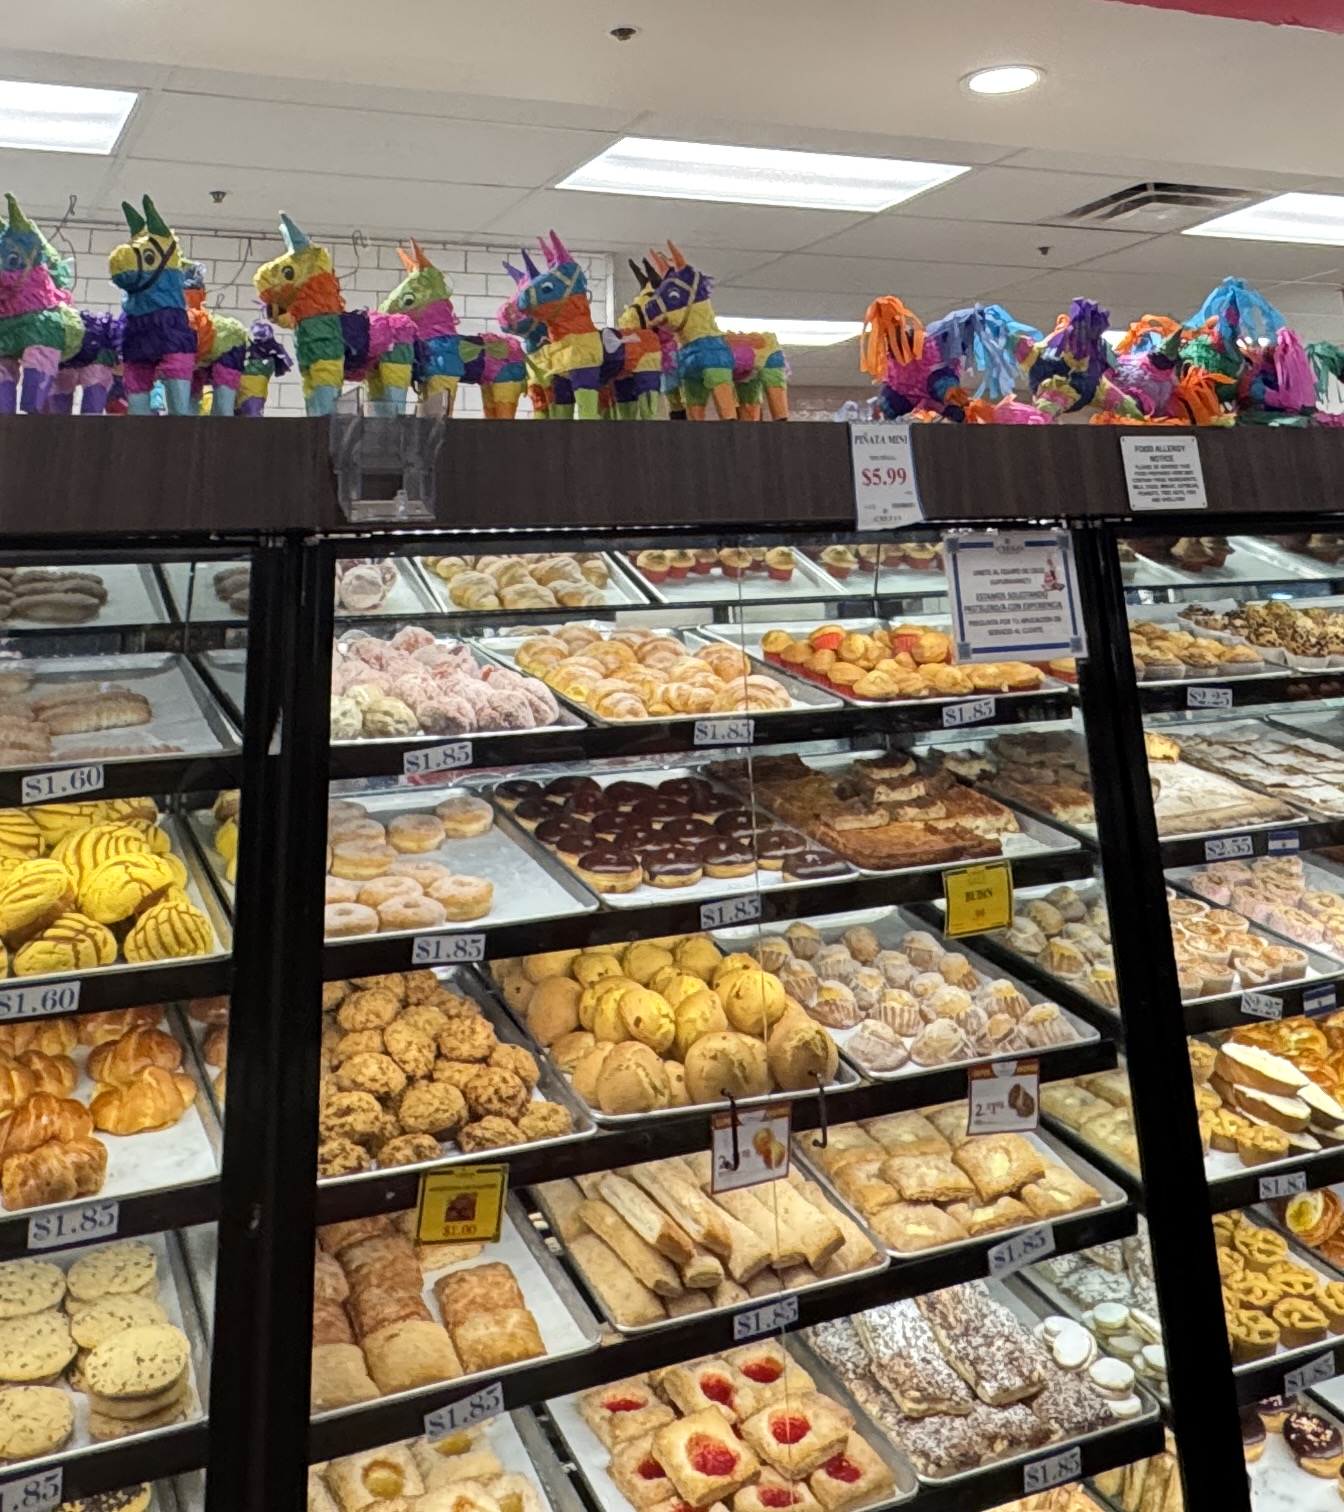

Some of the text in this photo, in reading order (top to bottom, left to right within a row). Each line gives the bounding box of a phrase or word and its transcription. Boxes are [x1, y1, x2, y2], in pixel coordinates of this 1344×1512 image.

[887, 434, 908, 445] MINI
[861, 467, 907, 487] $5.99
[944, 700, 994, 725] $1.85
[1188, 689, 1231, 706] $2.25
[696, 721, 752, 741] $1.85
[405, 744, 471, 774] $1.85
[25, 766, 103, 799] $1.60
[702, 897, 760, 927] $1.85
[415, 938, 483, 961] $1.85
[32, 1202, 116, 1242] $1.85
[992, 1229, 1047, 1269] $1.85
[736, 1300, 798, 1336] $1.85
[428, 1386, 502, 1435] $1.85
[1026, 1451, 1082, 1488] $1.85
